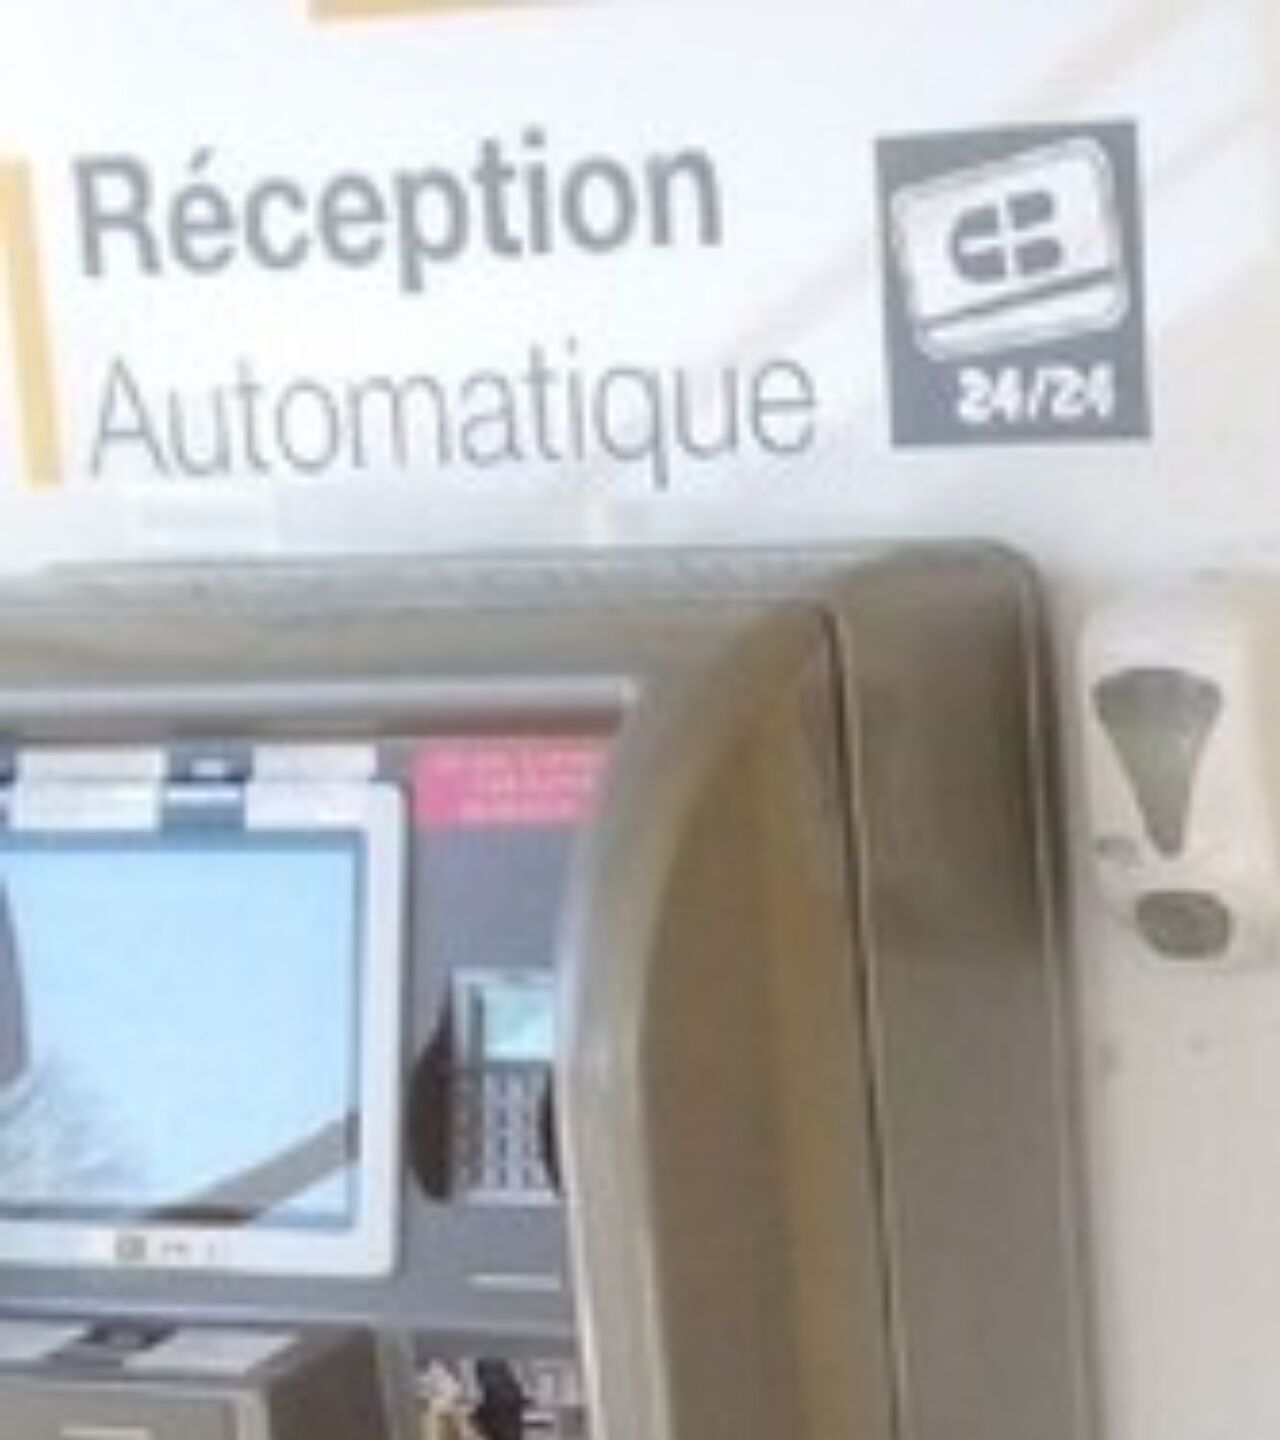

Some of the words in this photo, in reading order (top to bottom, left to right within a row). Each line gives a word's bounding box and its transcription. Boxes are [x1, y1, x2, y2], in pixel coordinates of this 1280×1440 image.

[72, 126, 724, 293] Réception
[88, 335, 819, 490] Automatique
[957, 362, 1115, 425] 24/24
